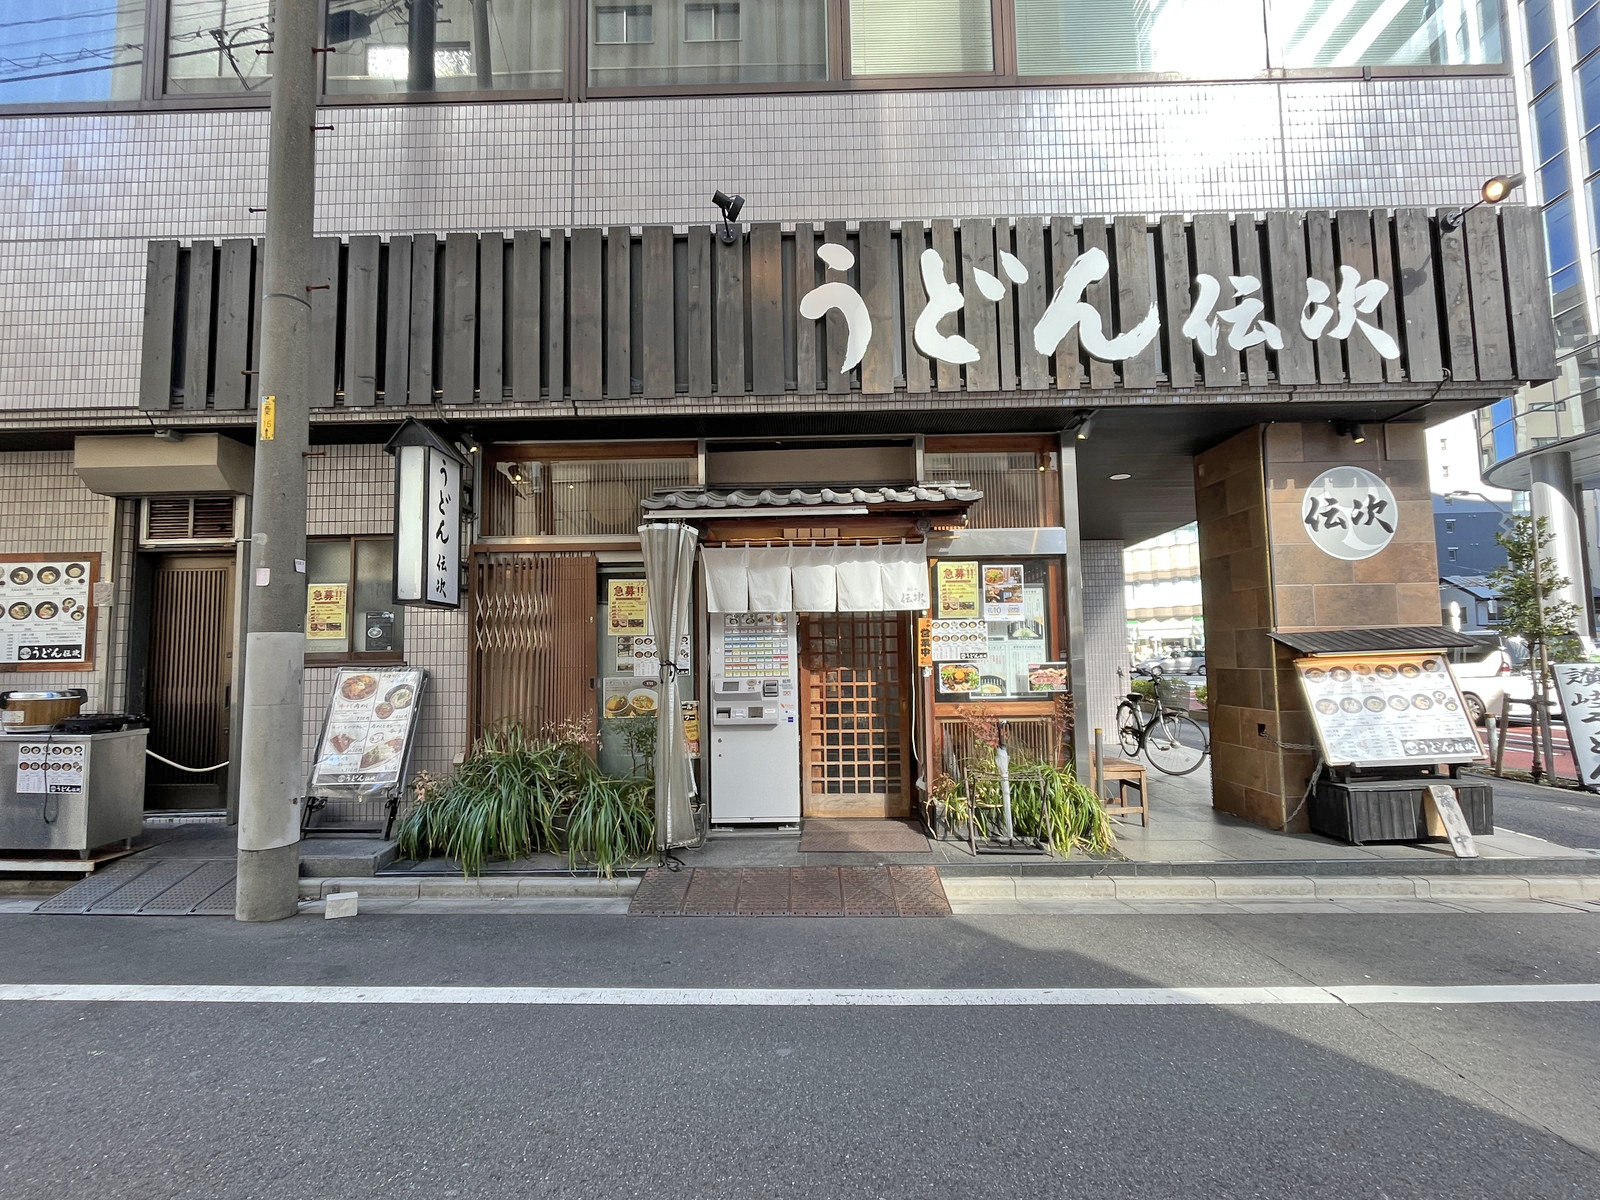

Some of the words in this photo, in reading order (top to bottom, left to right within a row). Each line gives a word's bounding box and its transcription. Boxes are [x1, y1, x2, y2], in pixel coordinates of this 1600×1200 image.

[799, 242, 1401, 374] うどん伝次
[435, 459, 452, 599] うどん伝次
[1304, 494, 1394, 534] 伝次
[1419, 740, 1477, 753] うどん伝次
